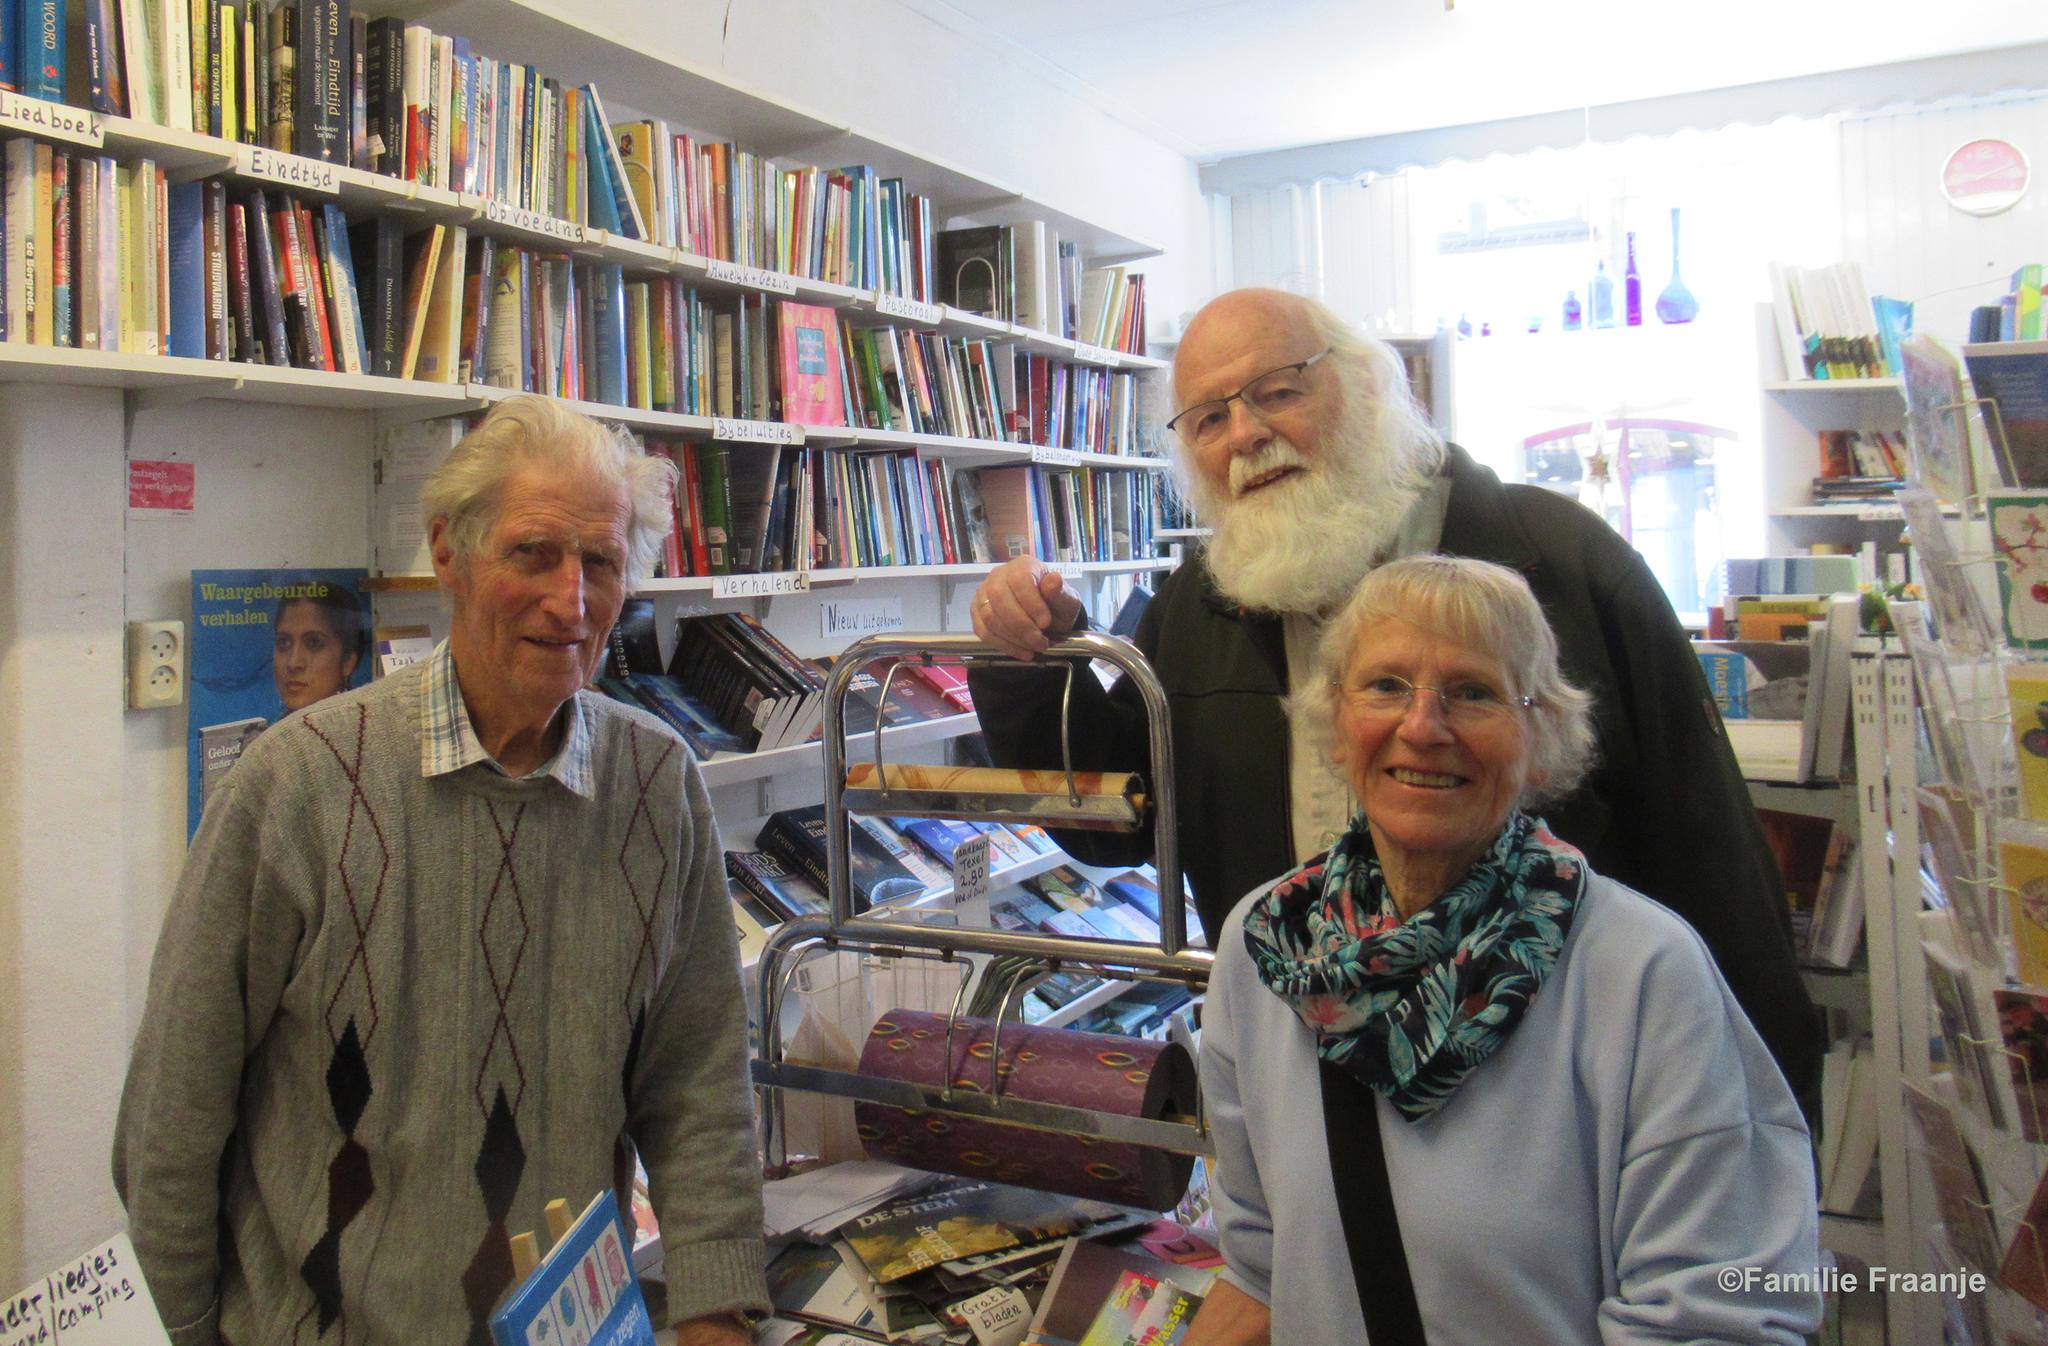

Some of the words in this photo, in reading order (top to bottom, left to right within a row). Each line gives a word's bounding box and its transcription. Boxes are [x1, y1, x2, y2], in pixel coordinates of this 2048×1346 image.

[43, 2, 56, 50] WOORD
[328, 0, 338, 36] even
[212, 54, 220, 65] DE
[212, 68, 220, 106] OPNAME
[328, 58, 341, 117] Eindtijd
[0, 91, 100, 138] Liedboek
[26, 241, 34, 257] de
[26, 259, 35, 312] Bergrede
[211, 252, 222, 319] STRIJDVAARDIG
[201, 582, 329, 604] Waargebeurde
[722, 574, 806, 595] Verhalend
[201, 610, 268, 626] verhalen
[828, 603, 859, 633] Nieuw
[208, 742, 241, 760] Geloof
[857, 1210, 892, 1229] DE
[893, 1198, 959, 1216] STEM
[961, 1288, 1013, 1315] Grati
[981, 1304, 1022, 1329] bladen
